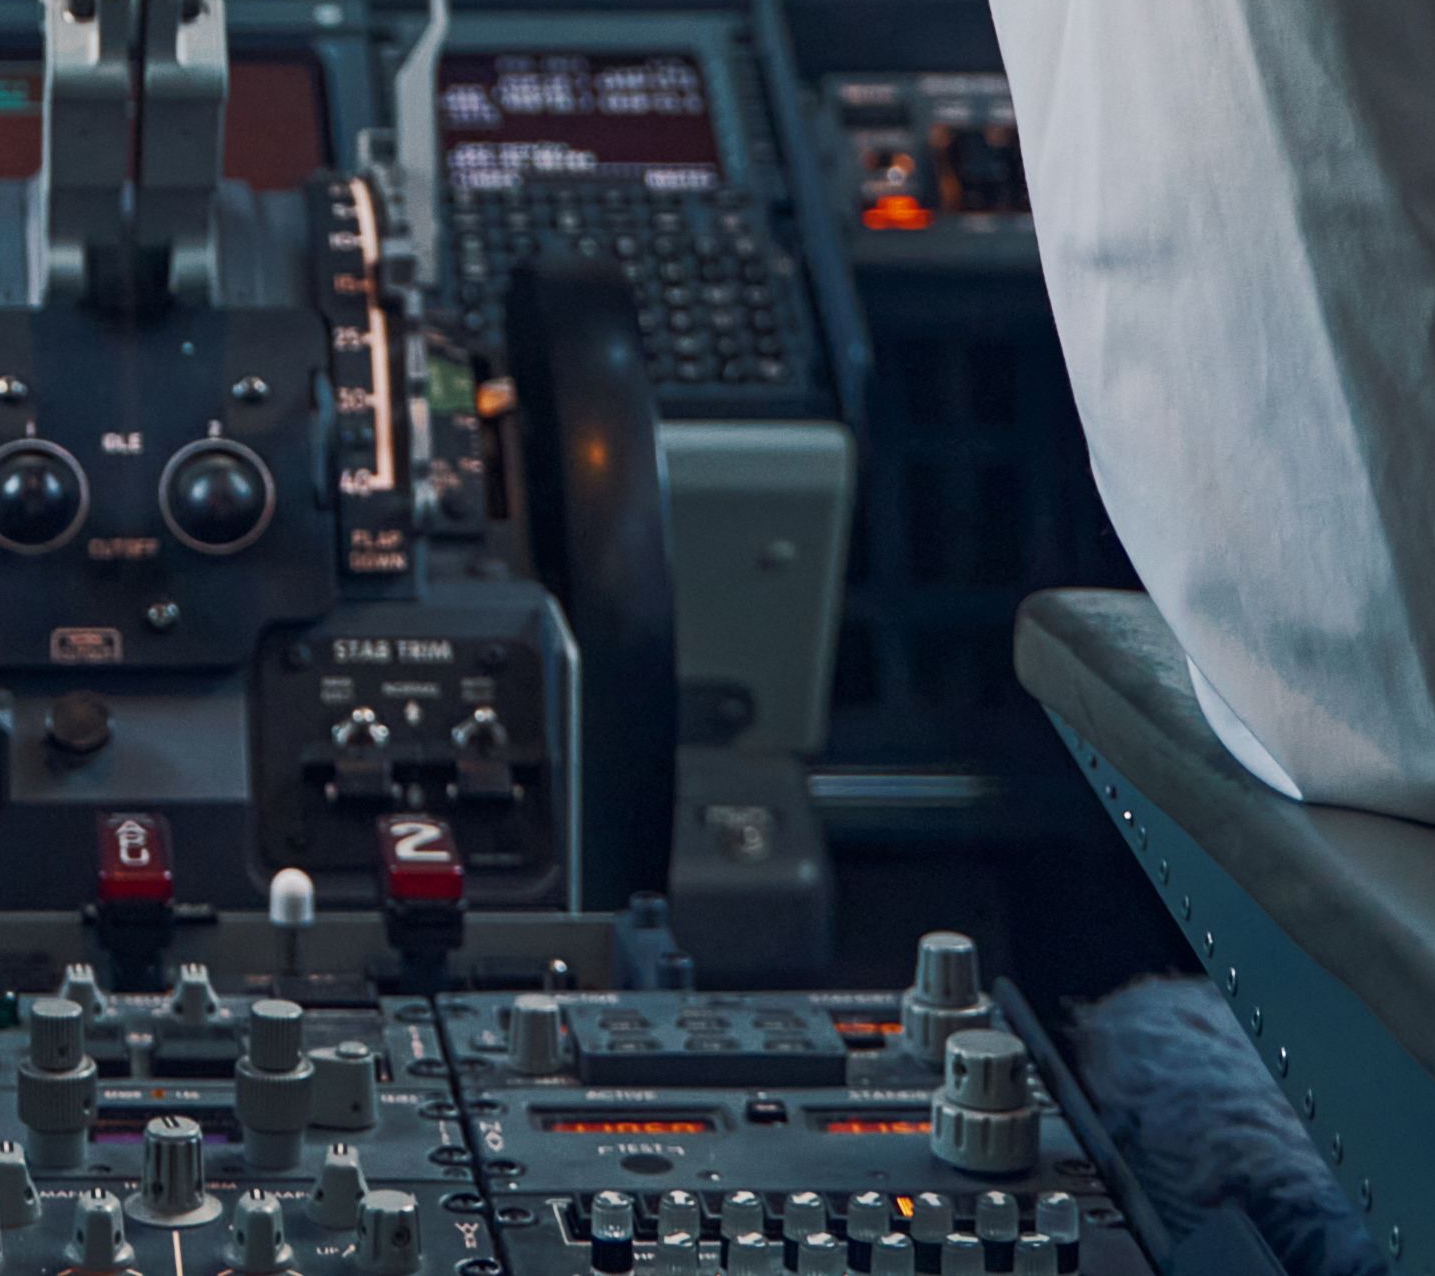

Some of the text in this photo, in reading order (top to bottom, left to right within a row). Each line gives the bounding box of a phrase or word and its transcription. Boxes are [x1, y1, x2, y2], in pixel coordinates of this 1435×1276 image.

[333, 638, 454, 664] STAB TRIM
[389, 821, 451, 862] 2
